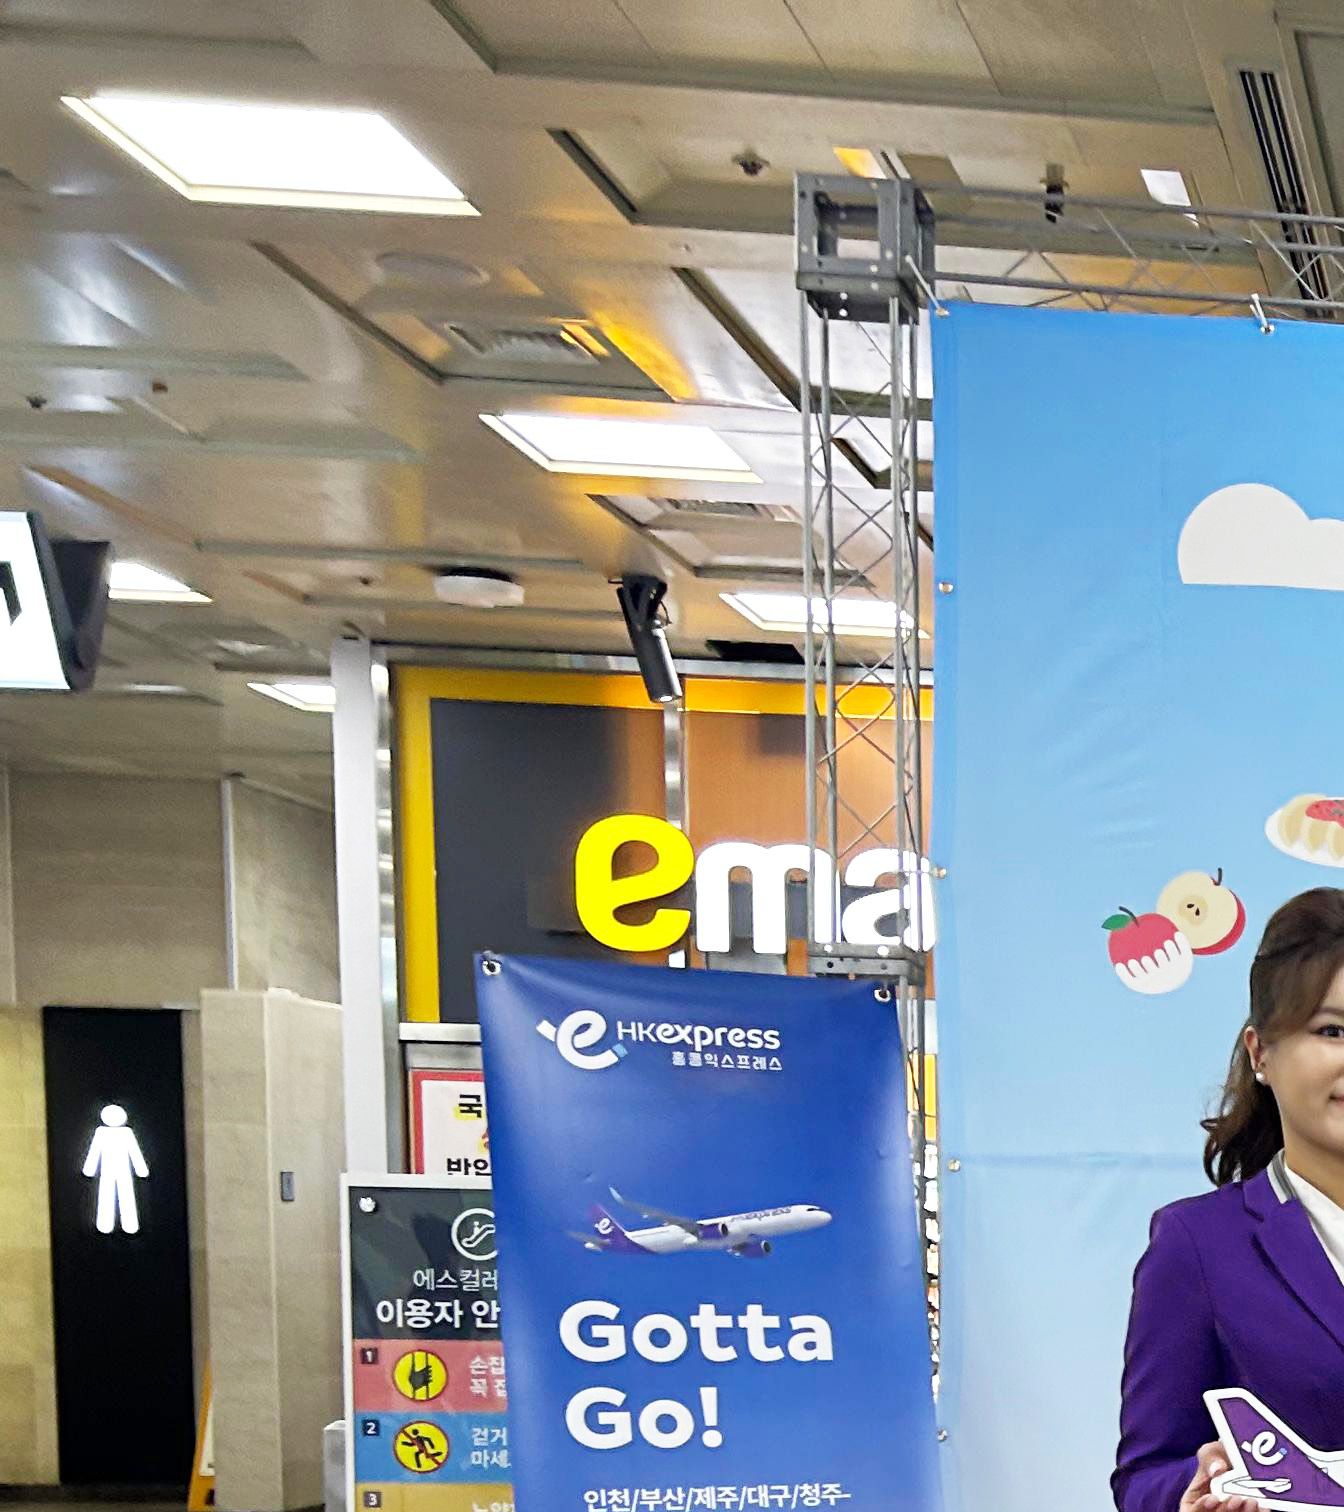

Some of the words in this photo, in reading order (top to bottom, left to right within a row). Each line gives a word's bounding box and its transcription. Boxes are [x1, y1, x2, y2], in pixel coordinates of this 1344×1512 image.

[617, 1021, 781, 1052] HKexpress
[672, 1051, 783, 1072] 홍콩익스프레스
[376, 1298, 463, 1329] 이용자
[471, 1299, 502, 1329] 안
[559, 1299, 834, 1363] Gotta
[565, 1386, 724, 1450] Go!
[471, 1447, 512, 1469] 마세
